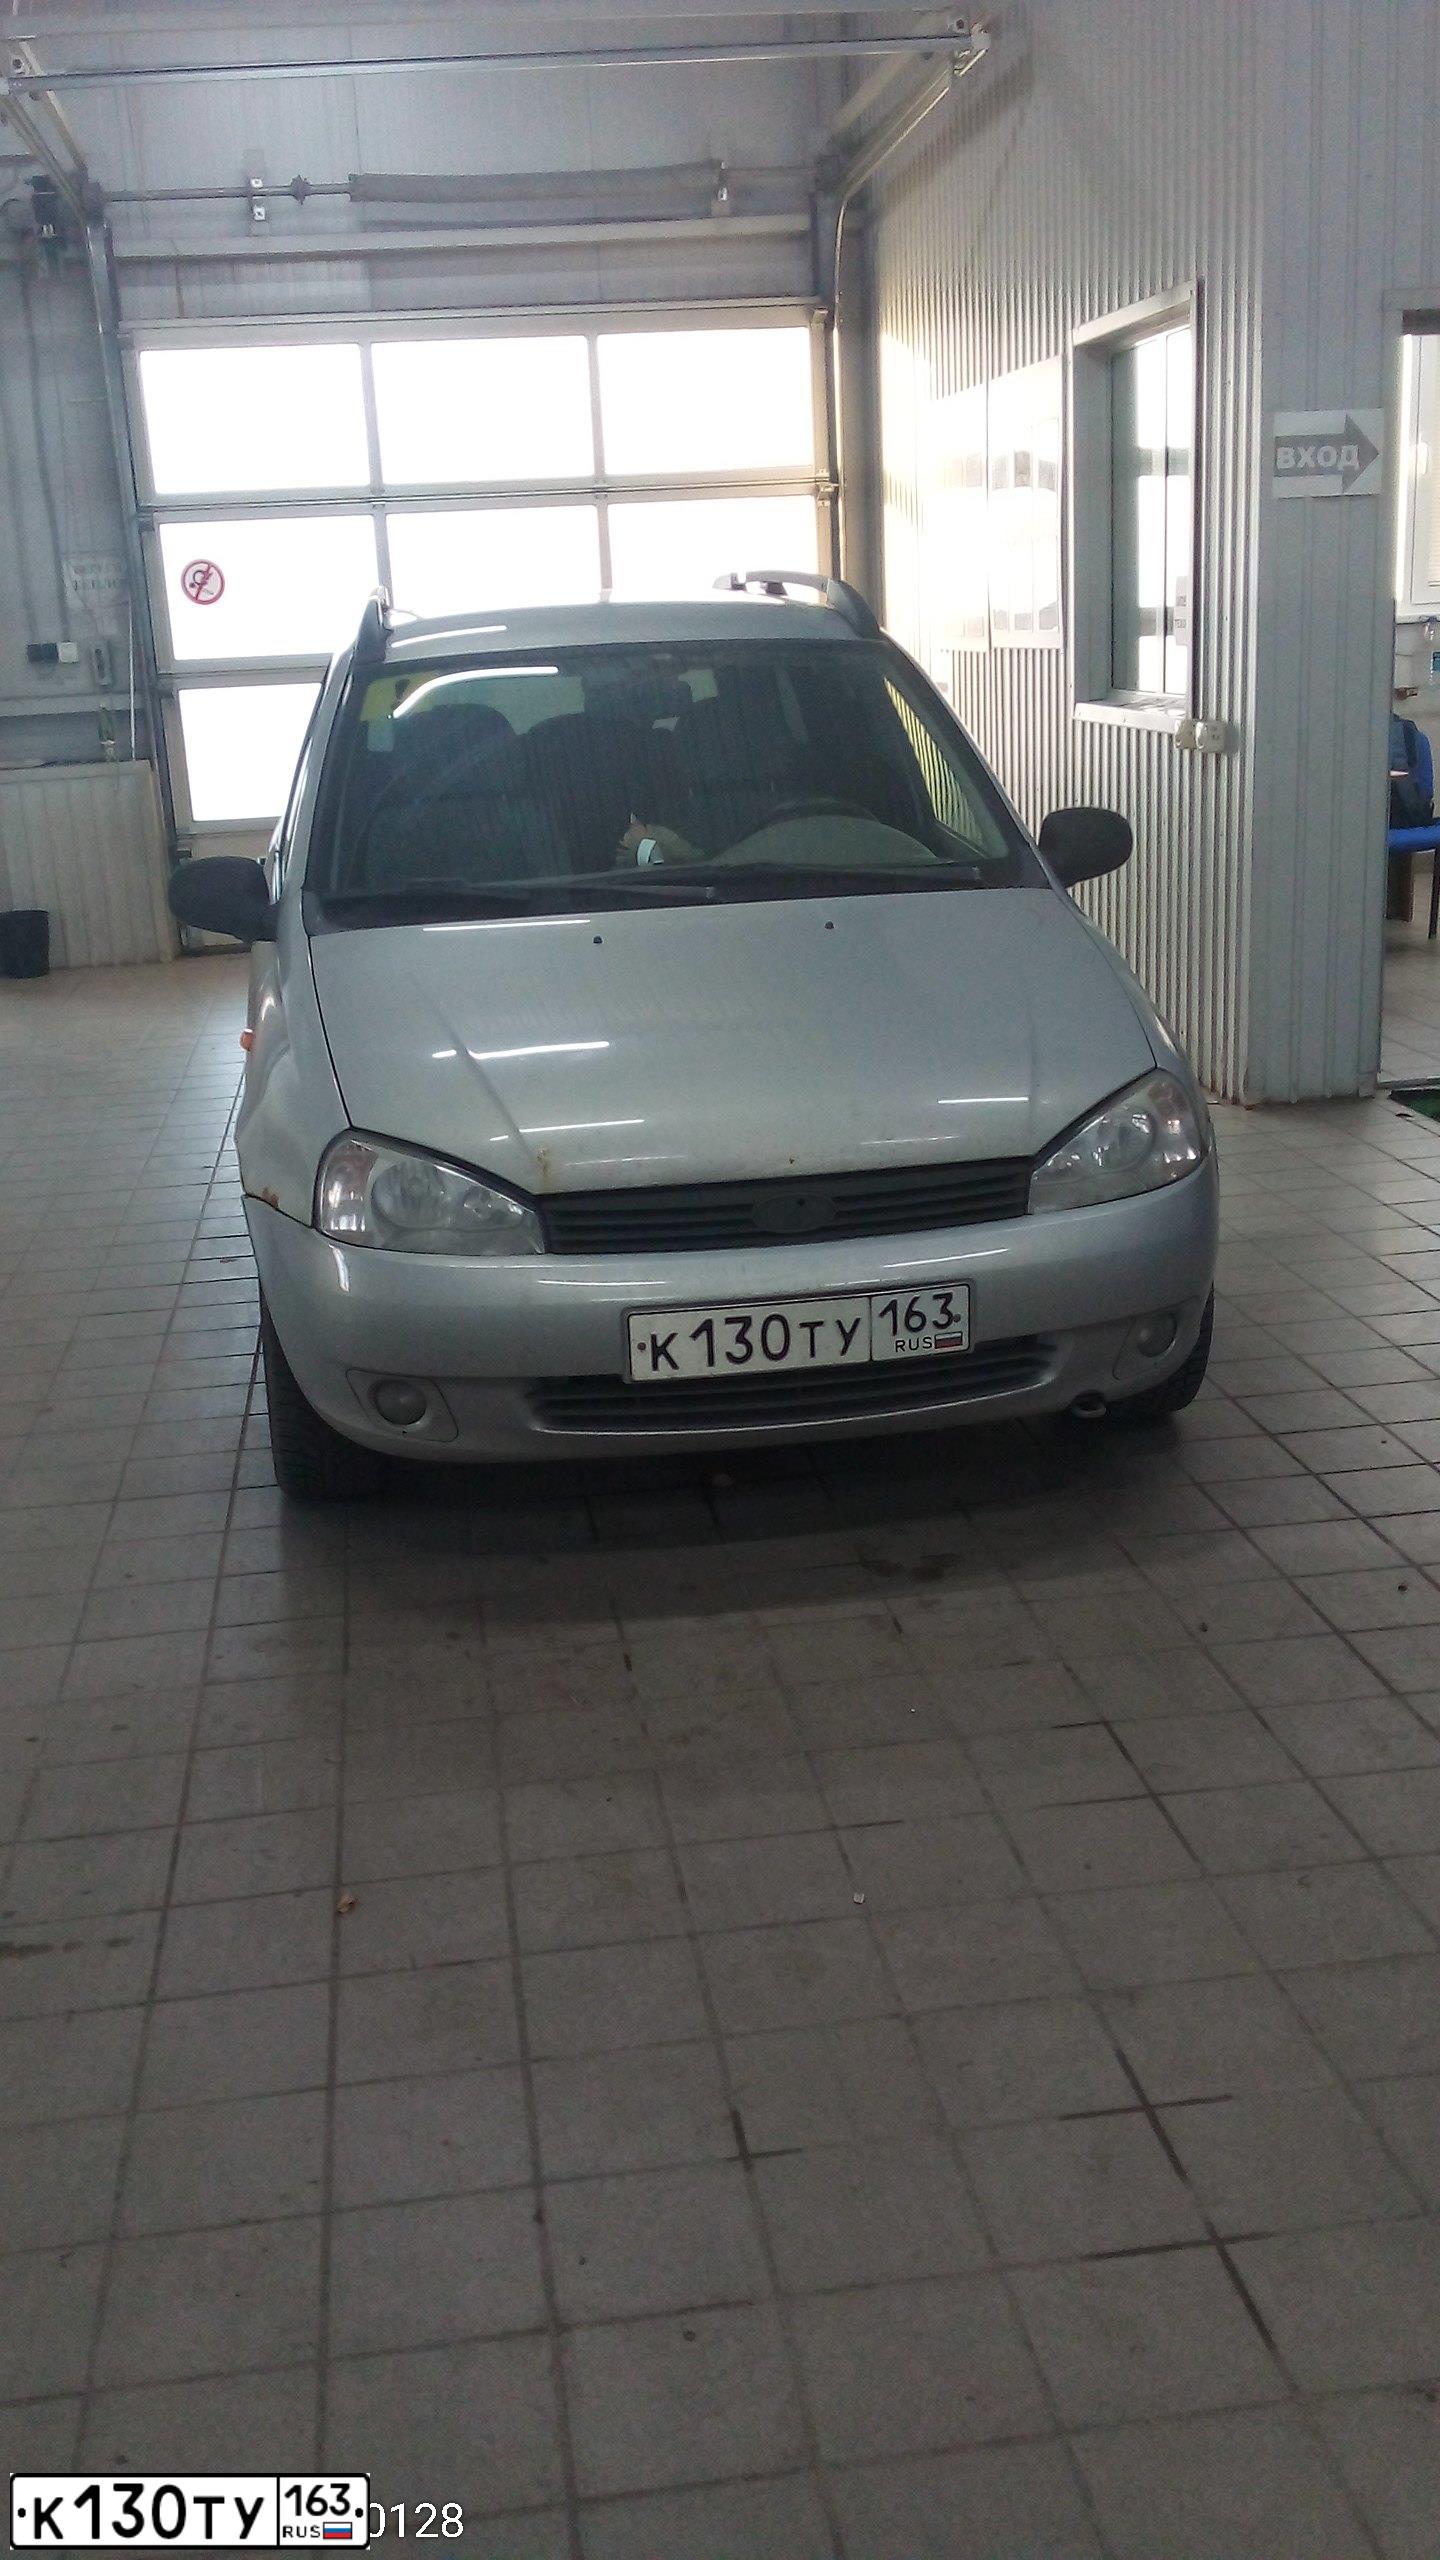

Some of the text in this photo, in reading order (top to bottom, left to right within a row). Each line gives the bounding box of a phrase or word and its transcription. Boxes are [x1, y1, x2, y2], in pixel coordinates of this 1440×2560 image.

[1276, 445, 1360, 471] ВХОД
[650, 1292, 954, 1372] К130ТУ 163
[895, 1336, 932, 1352] RUS
